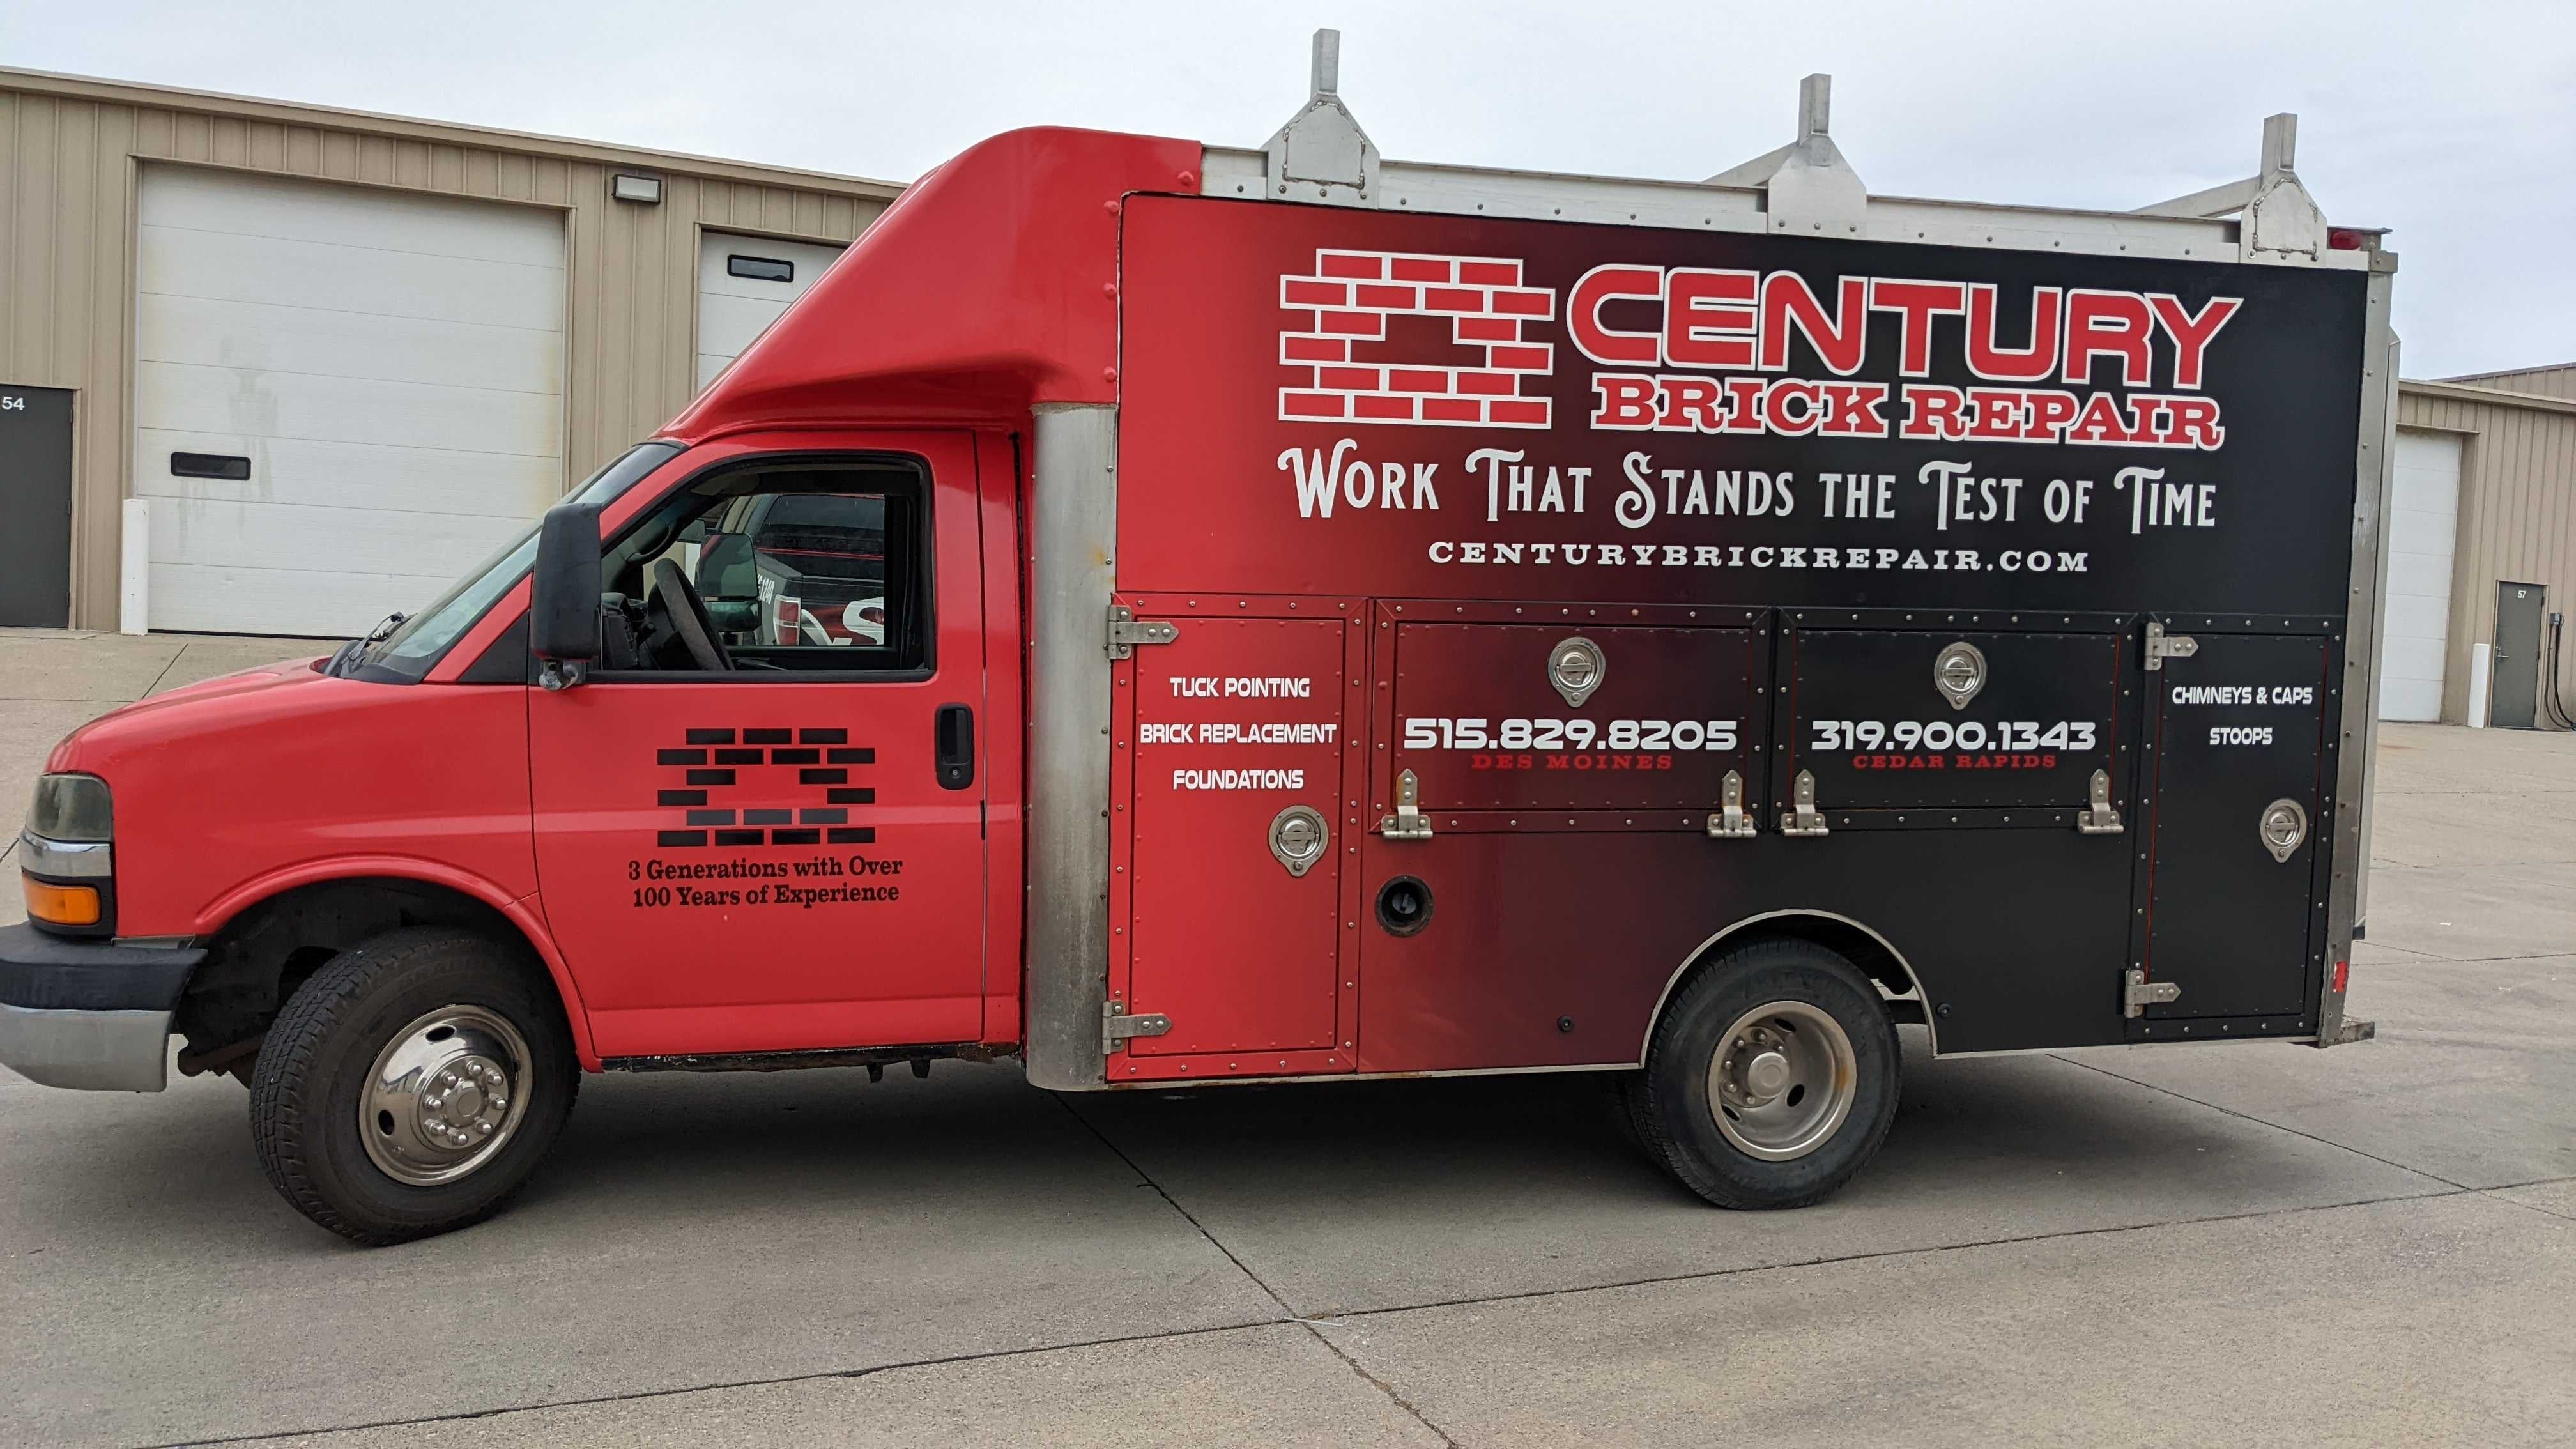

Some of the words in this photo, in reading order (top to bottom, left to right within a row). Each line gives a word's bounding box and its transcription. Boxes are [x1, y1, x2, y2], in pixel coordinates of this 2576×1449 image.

[1566, 263, 2244, 390] CENTURY
[1, 396, 25, 411] 54
[1590, 372, 1889, 438] BRICK
[1899, 383, 2225, 452] REPAIR
[1819, 473, 1896, 518] THE
[2044, 480, 2093, 523] OF
[1429, 542, 2087, 571] CENTURYBRICKREPAIR.COM
[2517, 590, 2527, 599] 57
[1170, 677, 1219, 696] TUCK
[1225, 678, 1310, 697] POINTING
[2172, 687, 2251, 704] CHIMNEYS
[2257, 687, 2267, 704] &
[2273, 687, 2312, 704] CAPS
[1140, 724, 1193, 743] BRICK
[1200, 724, 1337, 743] REPLACEMENT
[1404, 718, 1736, 750] 515.829.8205
[1812, 721, 2095, 750] 319.900.1343
[2210, 728, 2272, 744] STOOPS
[1471, 754, 1533, 769] DES
[1547, 754, 1671, 770] MOINES
[1853, 756, 1943, 769] CEDAR
[1958, 756, 2055, 767] RAPIDS
[1174, 770, 1303, 789] FOUNDATIONS
[629, 861, 640, 880] 3
[647, 859, 788, 880] Generations
[793, 857, 843, 876] with
[850, 856, 903, 875] Over
[634, 887, 670, 907] 100
[677, 887, 740, 905] Years
[746, 885, 768, 904] of
[774, 882, 898, 908] Experience
